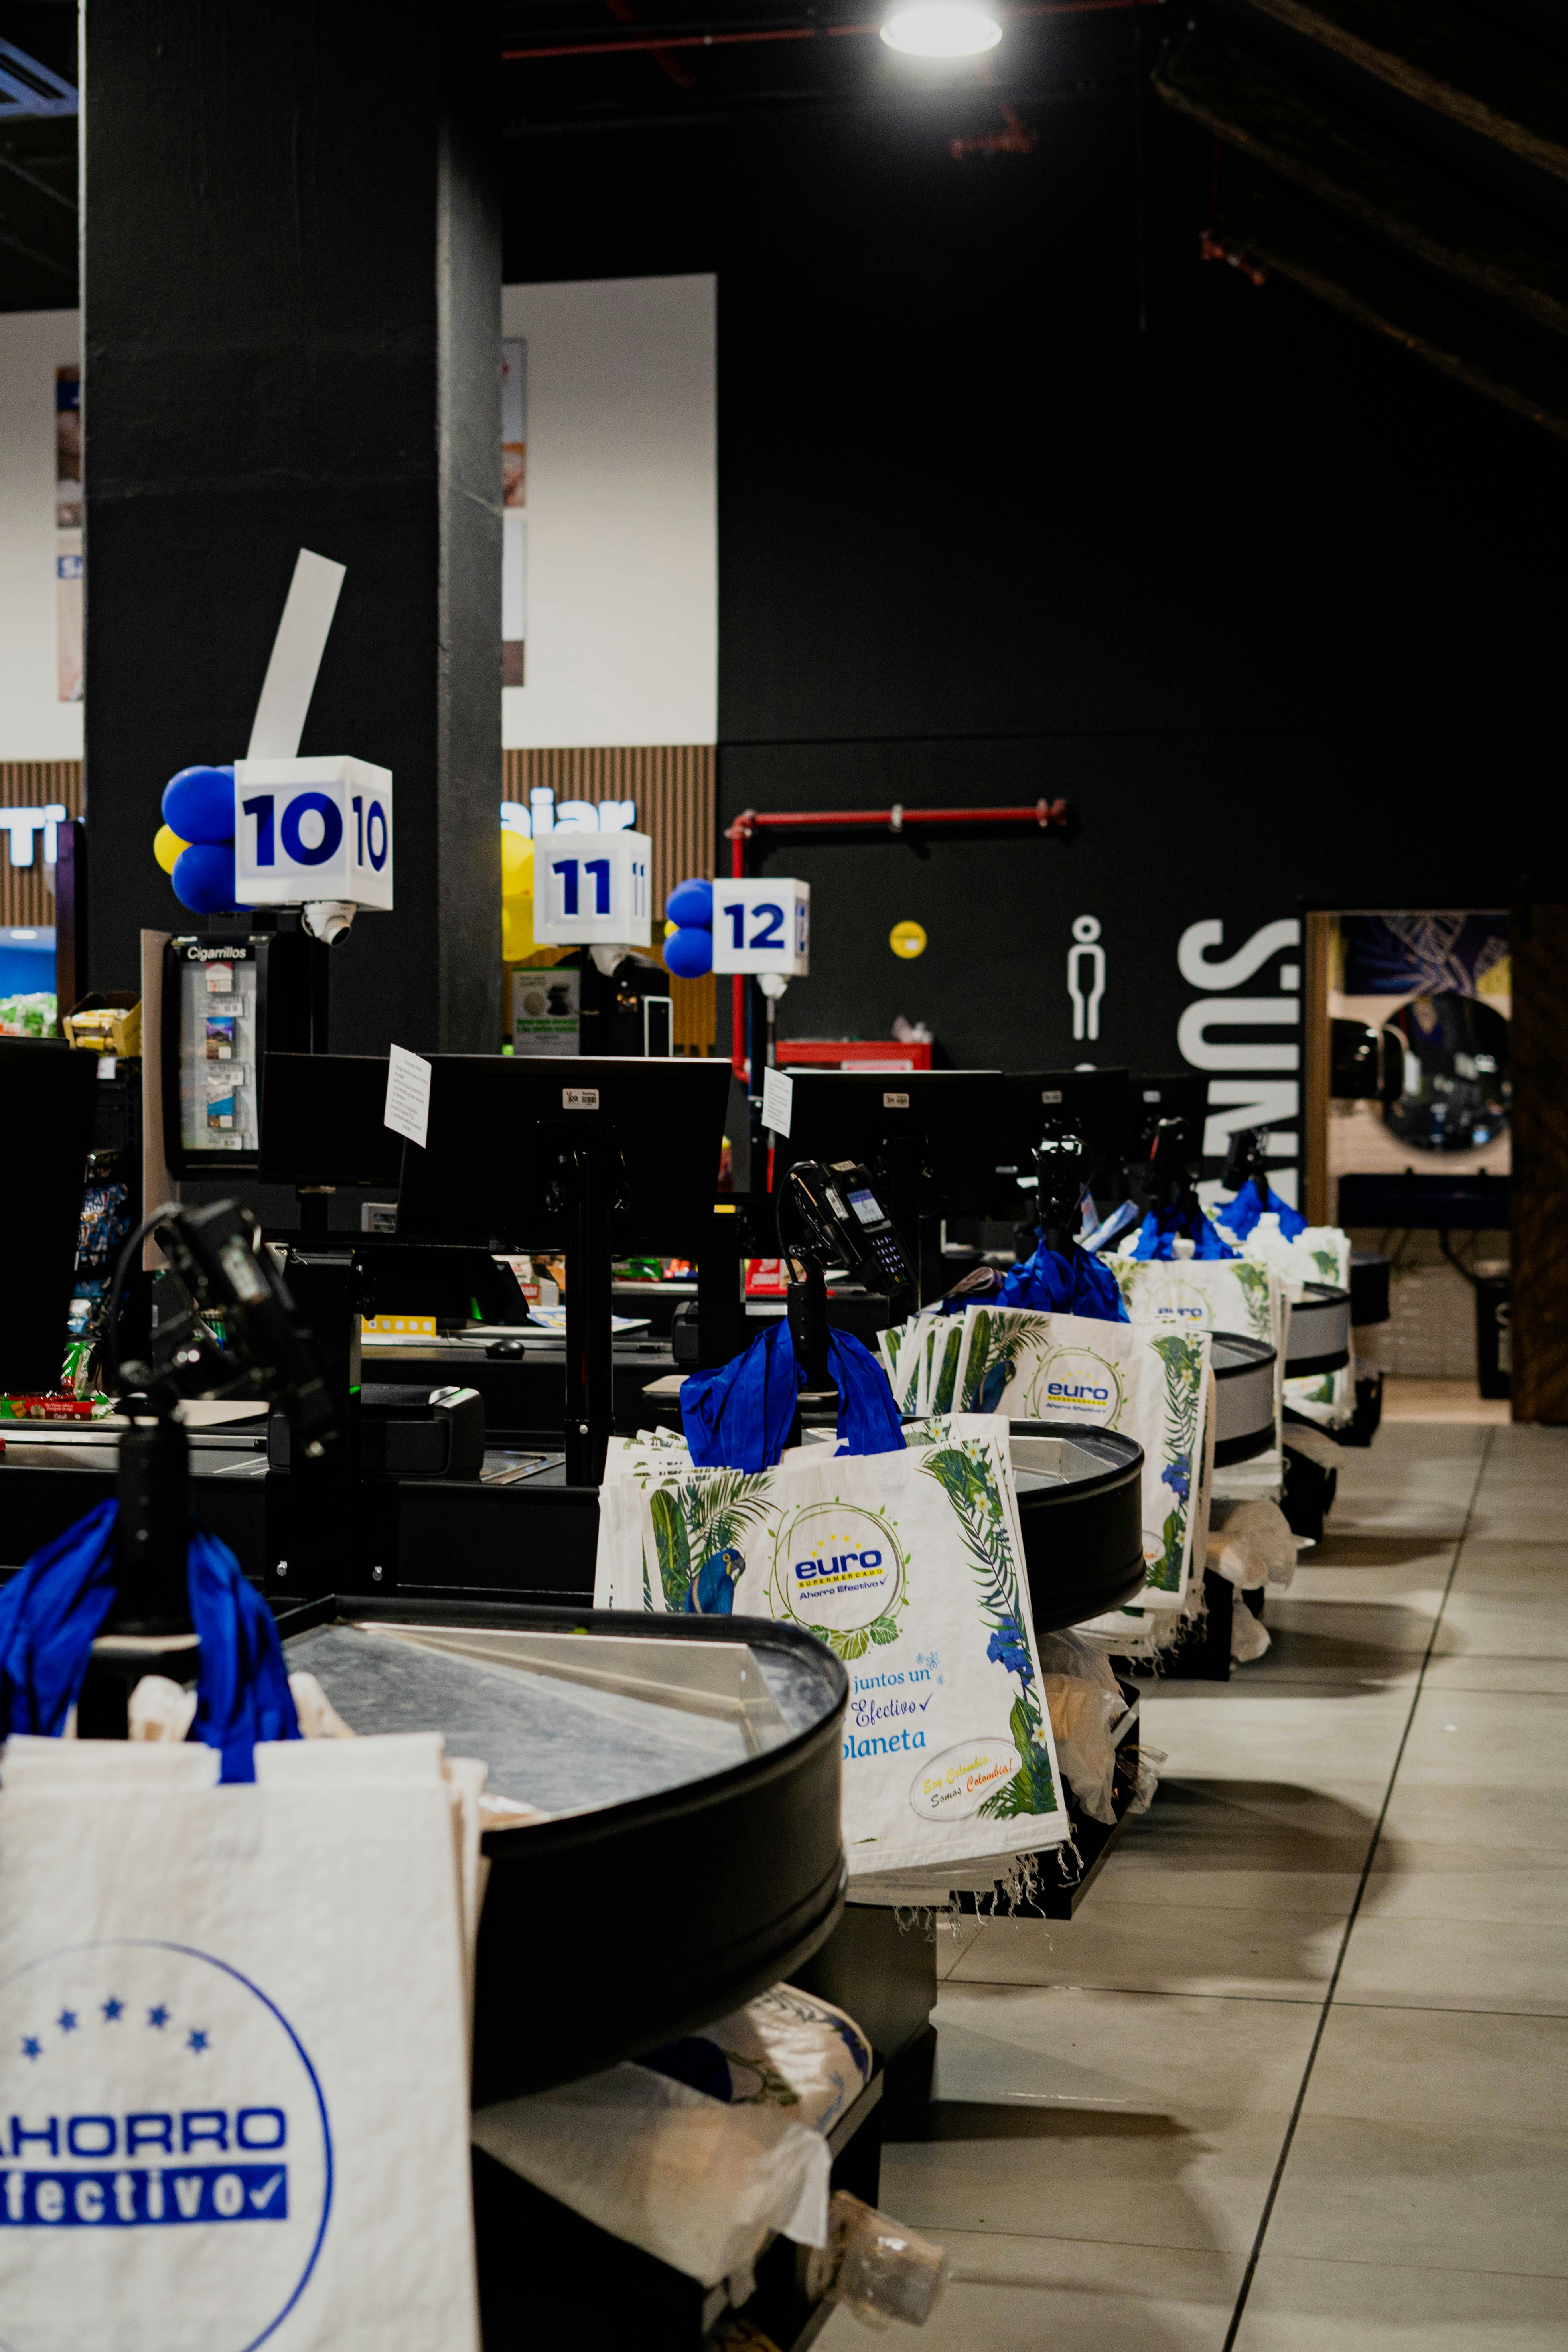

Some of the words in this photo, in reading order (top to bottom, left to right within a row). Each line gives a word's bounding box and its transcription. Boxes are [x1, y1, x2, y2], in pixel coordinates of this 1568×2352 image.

[242, 792, 343, 866] 10
[352, 795, 388, 872] 10
[552, 859, 610, 915] 11
[724, 903, 785, 949] 12
[187, 946, 247, 961] Cigarrillos
[1048, 1383, 1108, 1400] euro
[795, 1550, 882, 1579] euro
[799, 1569, 883, 1588] SUPERMERCADO
[799, 1589, 835, 1600] Ahorro
[837, 1581, 878, 1593] Efectivo
[854, 1673, 904, 1695] juntos
[909, 1669, 930, 1683] un
[851, 1699, 916, 1727] Efectivo
[922, 1778, 943, 1794] Soy
[931, 1787, 962, 1808] Somos
[966, 1757, 1013, 1793] Colombia!
[0, 2107, 286, 2157] HORRO
[3, 2169, 245, 2221] fectivo
